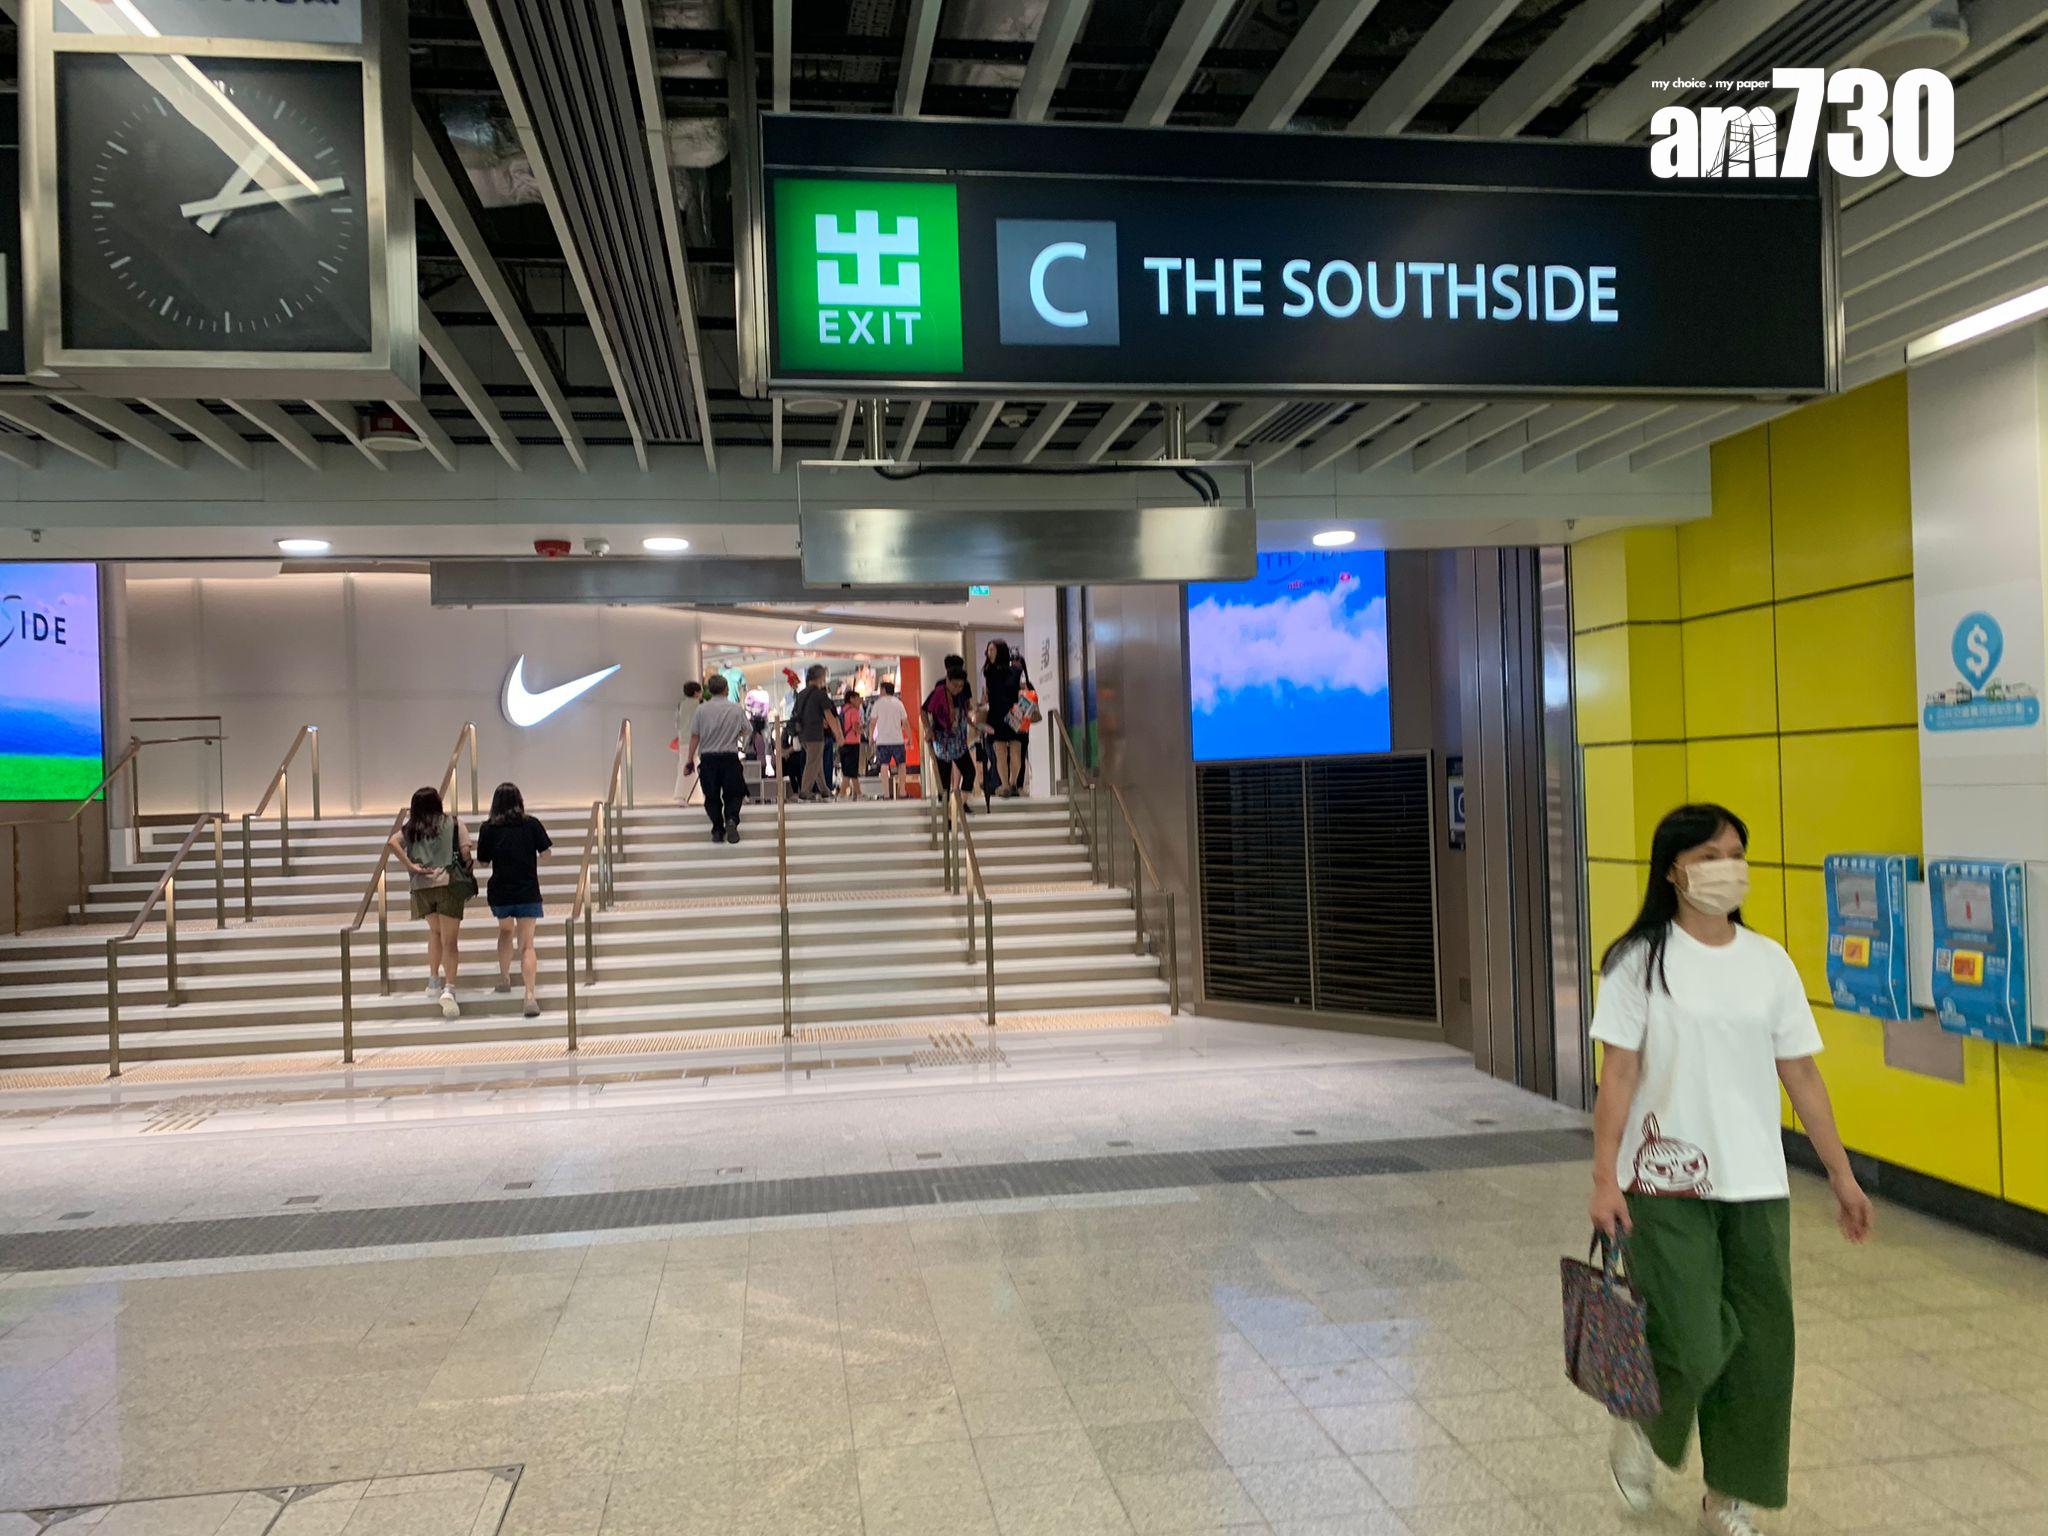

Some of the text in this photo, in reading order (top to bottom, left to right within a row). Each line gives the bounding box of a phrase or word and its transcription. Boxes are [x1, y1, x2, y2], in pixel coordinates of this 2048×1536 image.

[1029, 241, 1619, 328] C THE SOUTHSIDE
[818, 309, 921, 345] EXIT
